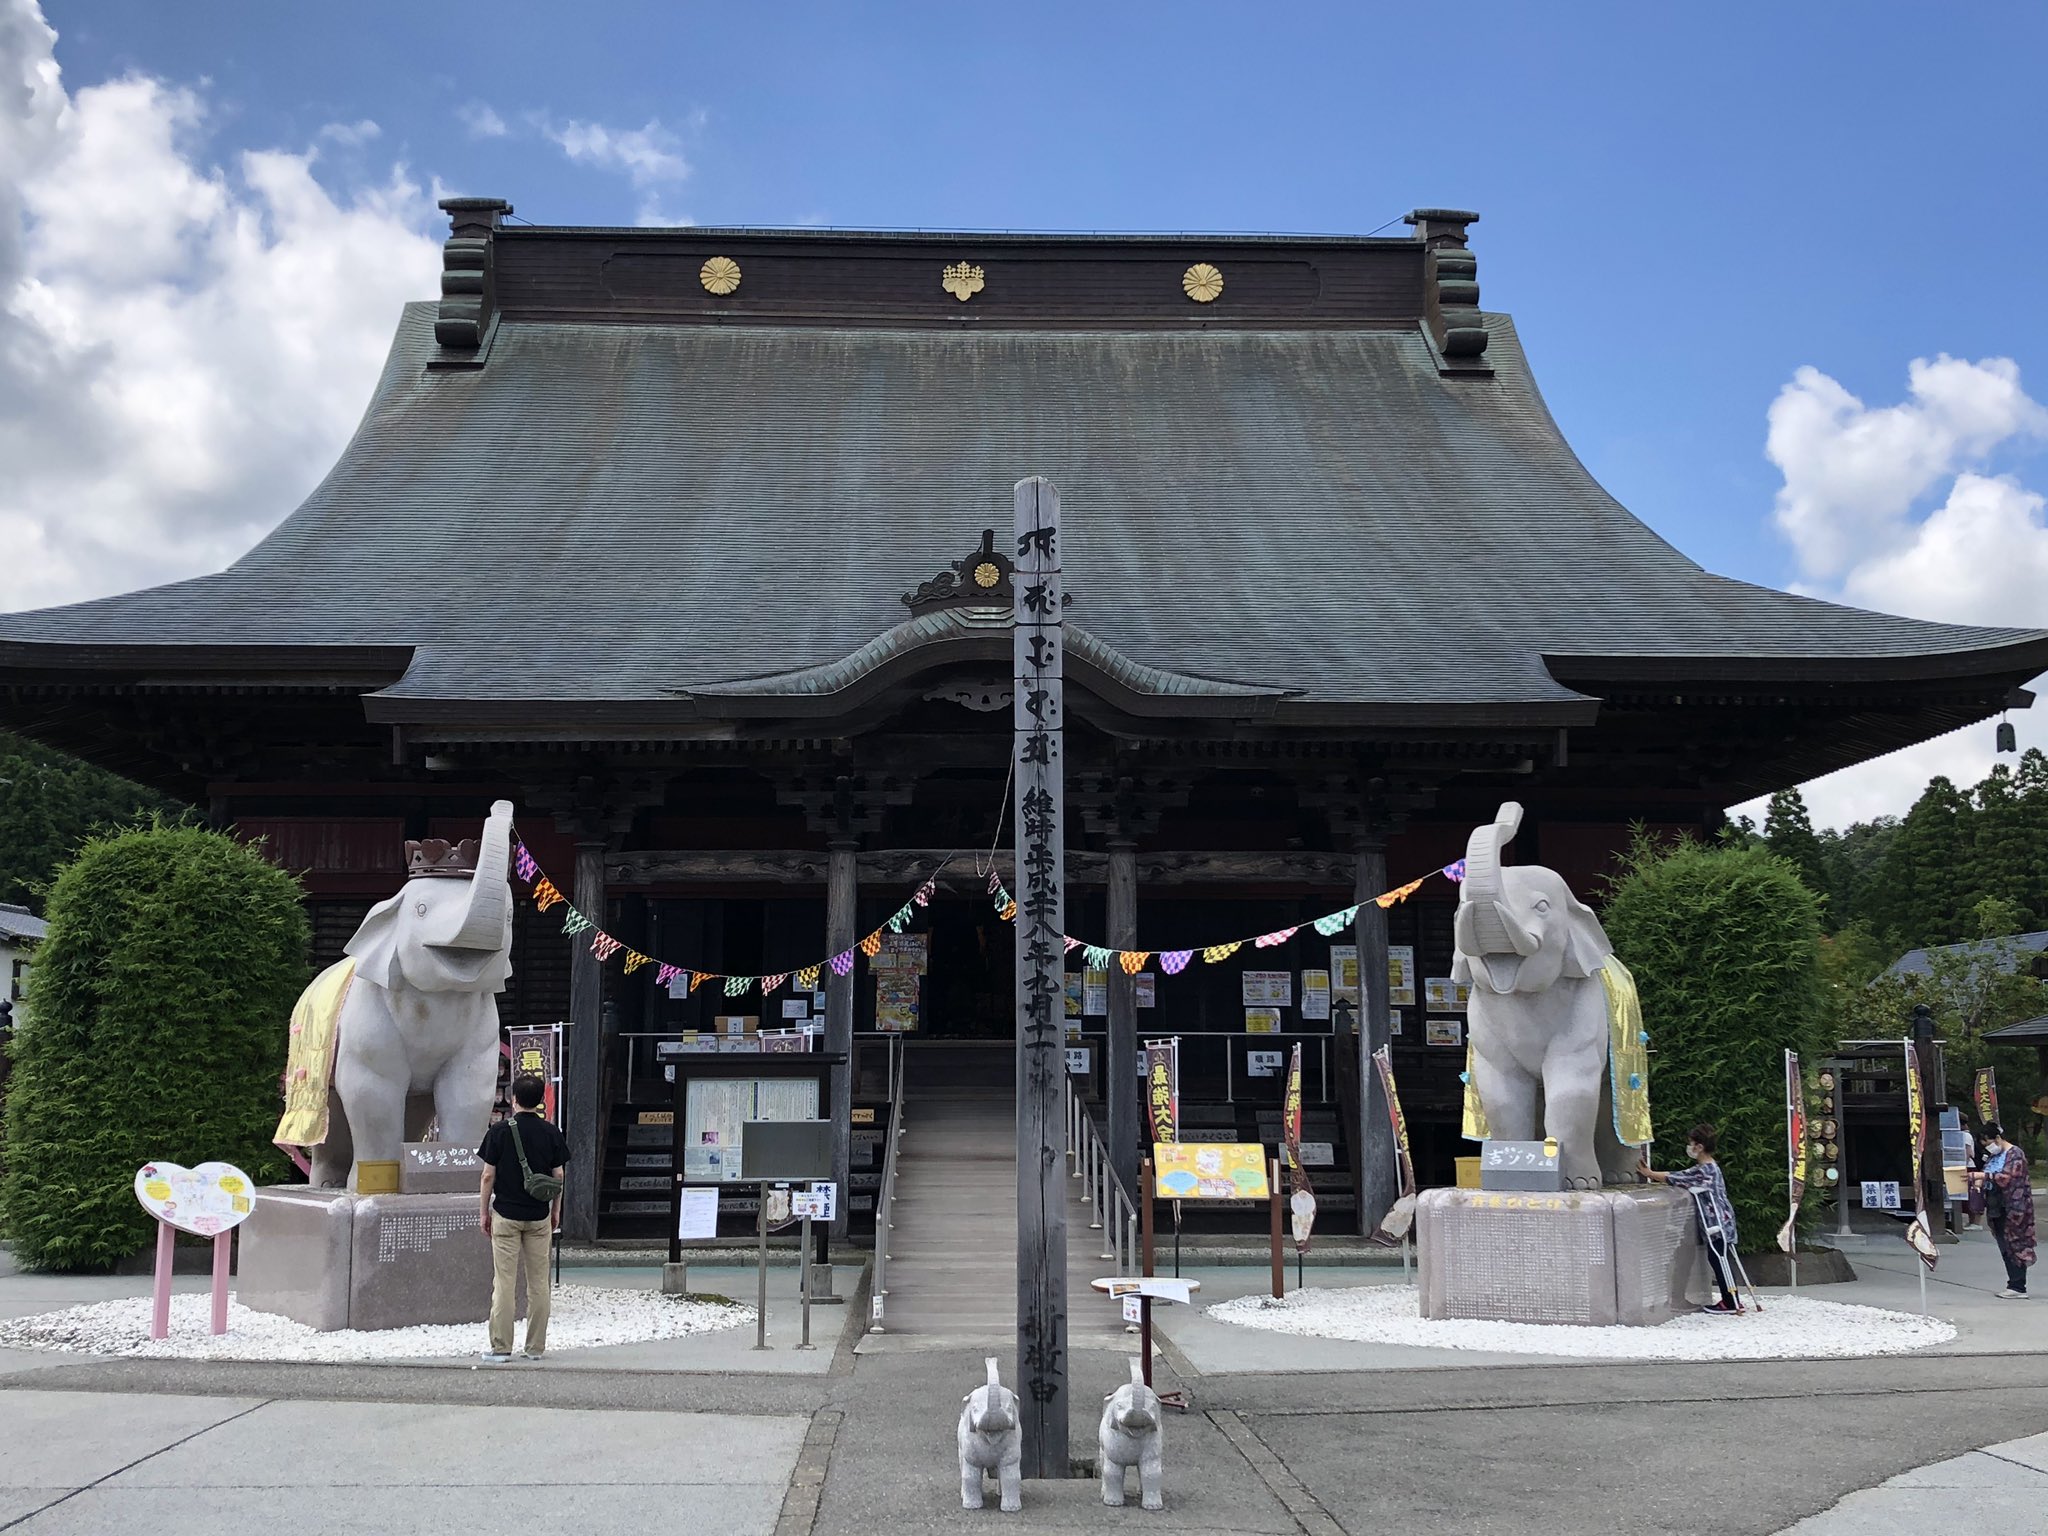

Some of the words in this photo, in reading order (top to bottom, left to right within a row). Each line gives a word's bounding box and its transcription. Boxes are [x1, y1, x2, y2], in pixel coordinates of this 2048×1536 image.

[1255, 1055, 1275, 1063] 順路
[1866, 1184, 1878, 1207] 禁煙
[1885, 1183, 1897, 1207] 禁煙
